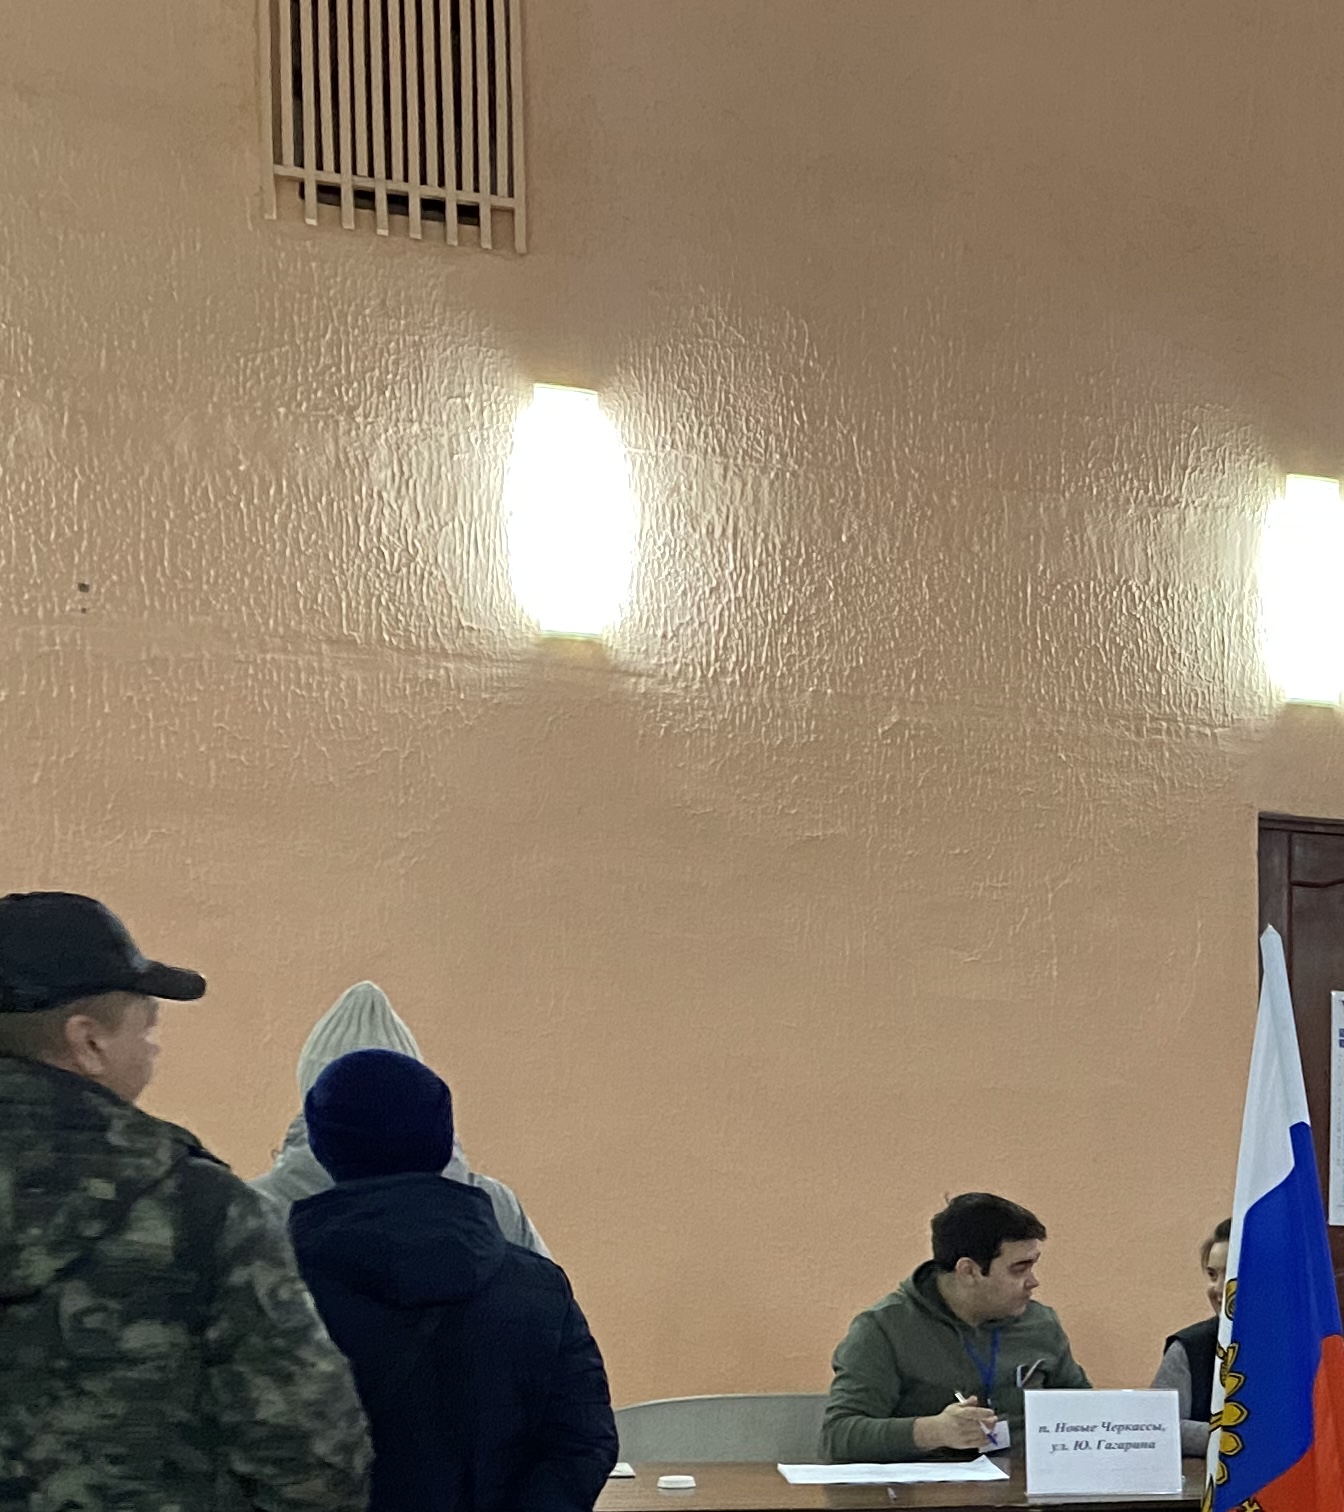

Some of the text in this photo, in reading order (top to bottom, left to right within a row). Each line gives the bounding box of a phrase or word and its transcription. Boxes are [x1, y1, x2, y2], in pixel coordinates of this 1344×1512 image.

[1055, 1422, 1098, 1433] Новые
[1101, 1421, 1166, 1435] Черкассы,
[1073, 1440, 1092, 1451] Ю.
[1096, 1439, 1156, 1454] Гагарина
